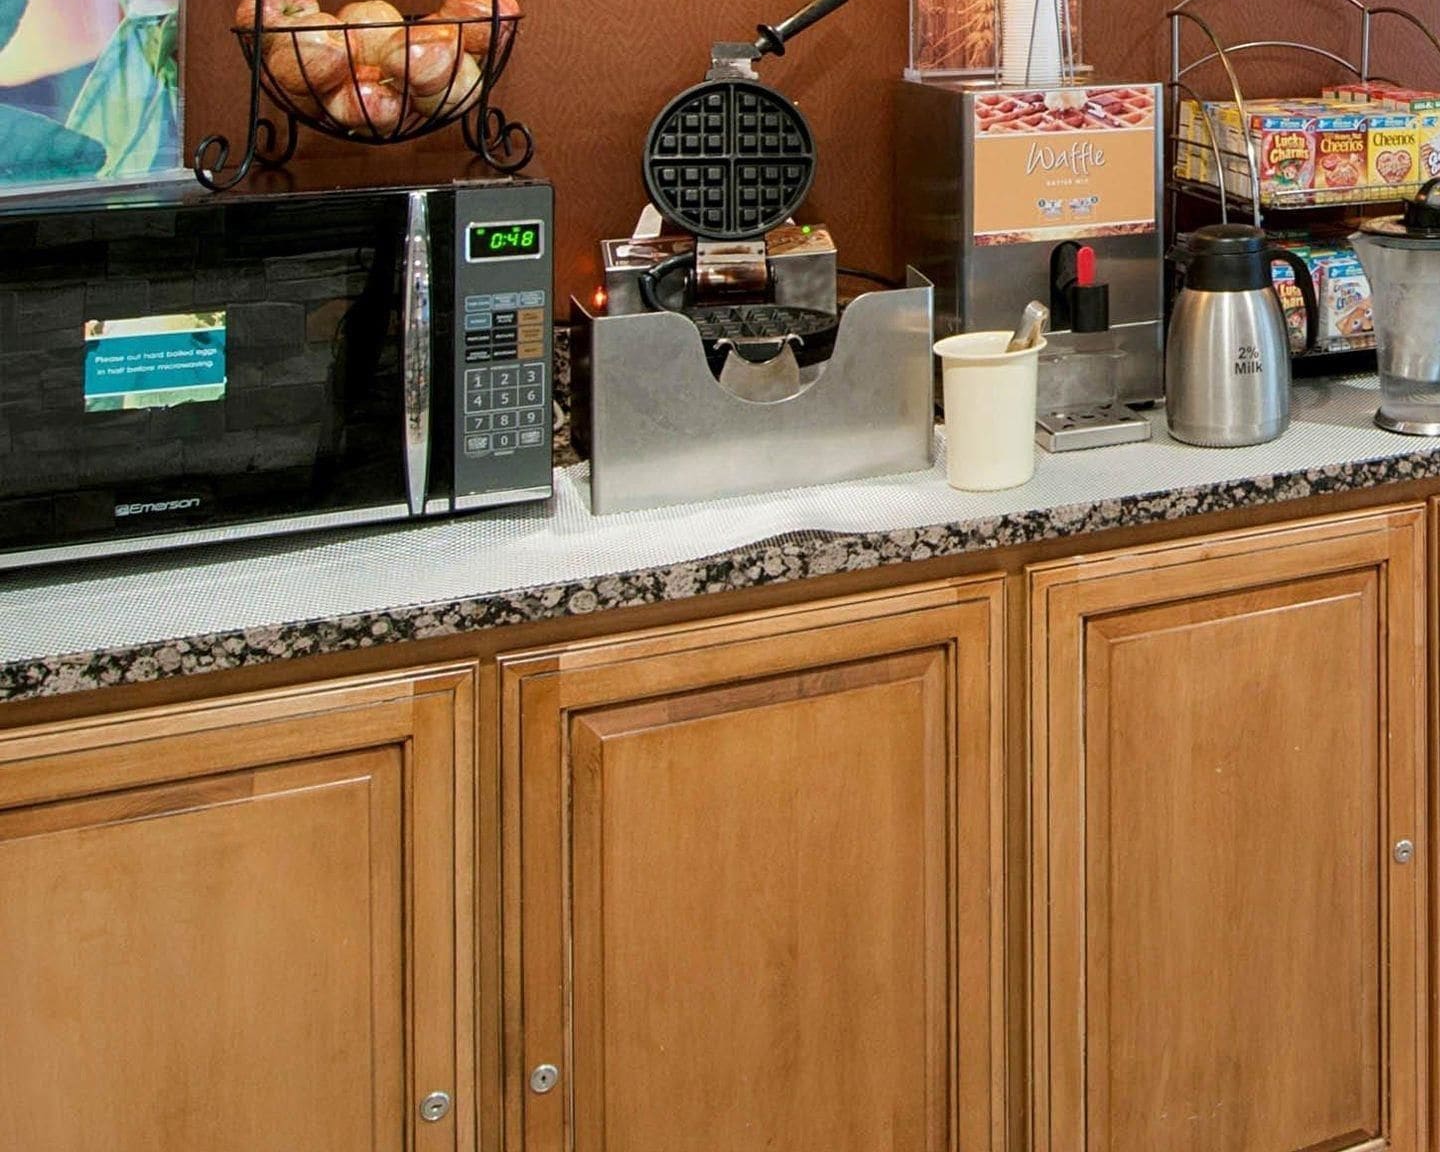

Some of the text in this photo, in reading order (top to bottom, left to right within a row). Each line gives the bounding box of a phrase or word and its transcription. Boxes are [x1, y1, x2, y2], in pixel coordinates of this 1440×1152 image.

[1274, 133, 1306, 149] Lucky
[1320, 137, 1364, 153] Cheerios
[1373, 132, 1415, 147] Cheerios
[1026, 141, 1105, 176] Waffle
[1269, 148, 1310, 165] Charms
[490, 230, 534, 249] 0:48
[143, 351, 164, 360] hard
[166, 348, 194, 358] boiled
[1238, 346, 1260, 359] 2%
[1235, 361, 1263, 375] Milk
[474, 370, 536, 388] 1 2 3
[473, 390, 536, 408] 4 5 6
[474, 412, 536, 429] 7 8 9
[500, 435, 509, 446] 0
[129, 498, 201, 515] Emerson
